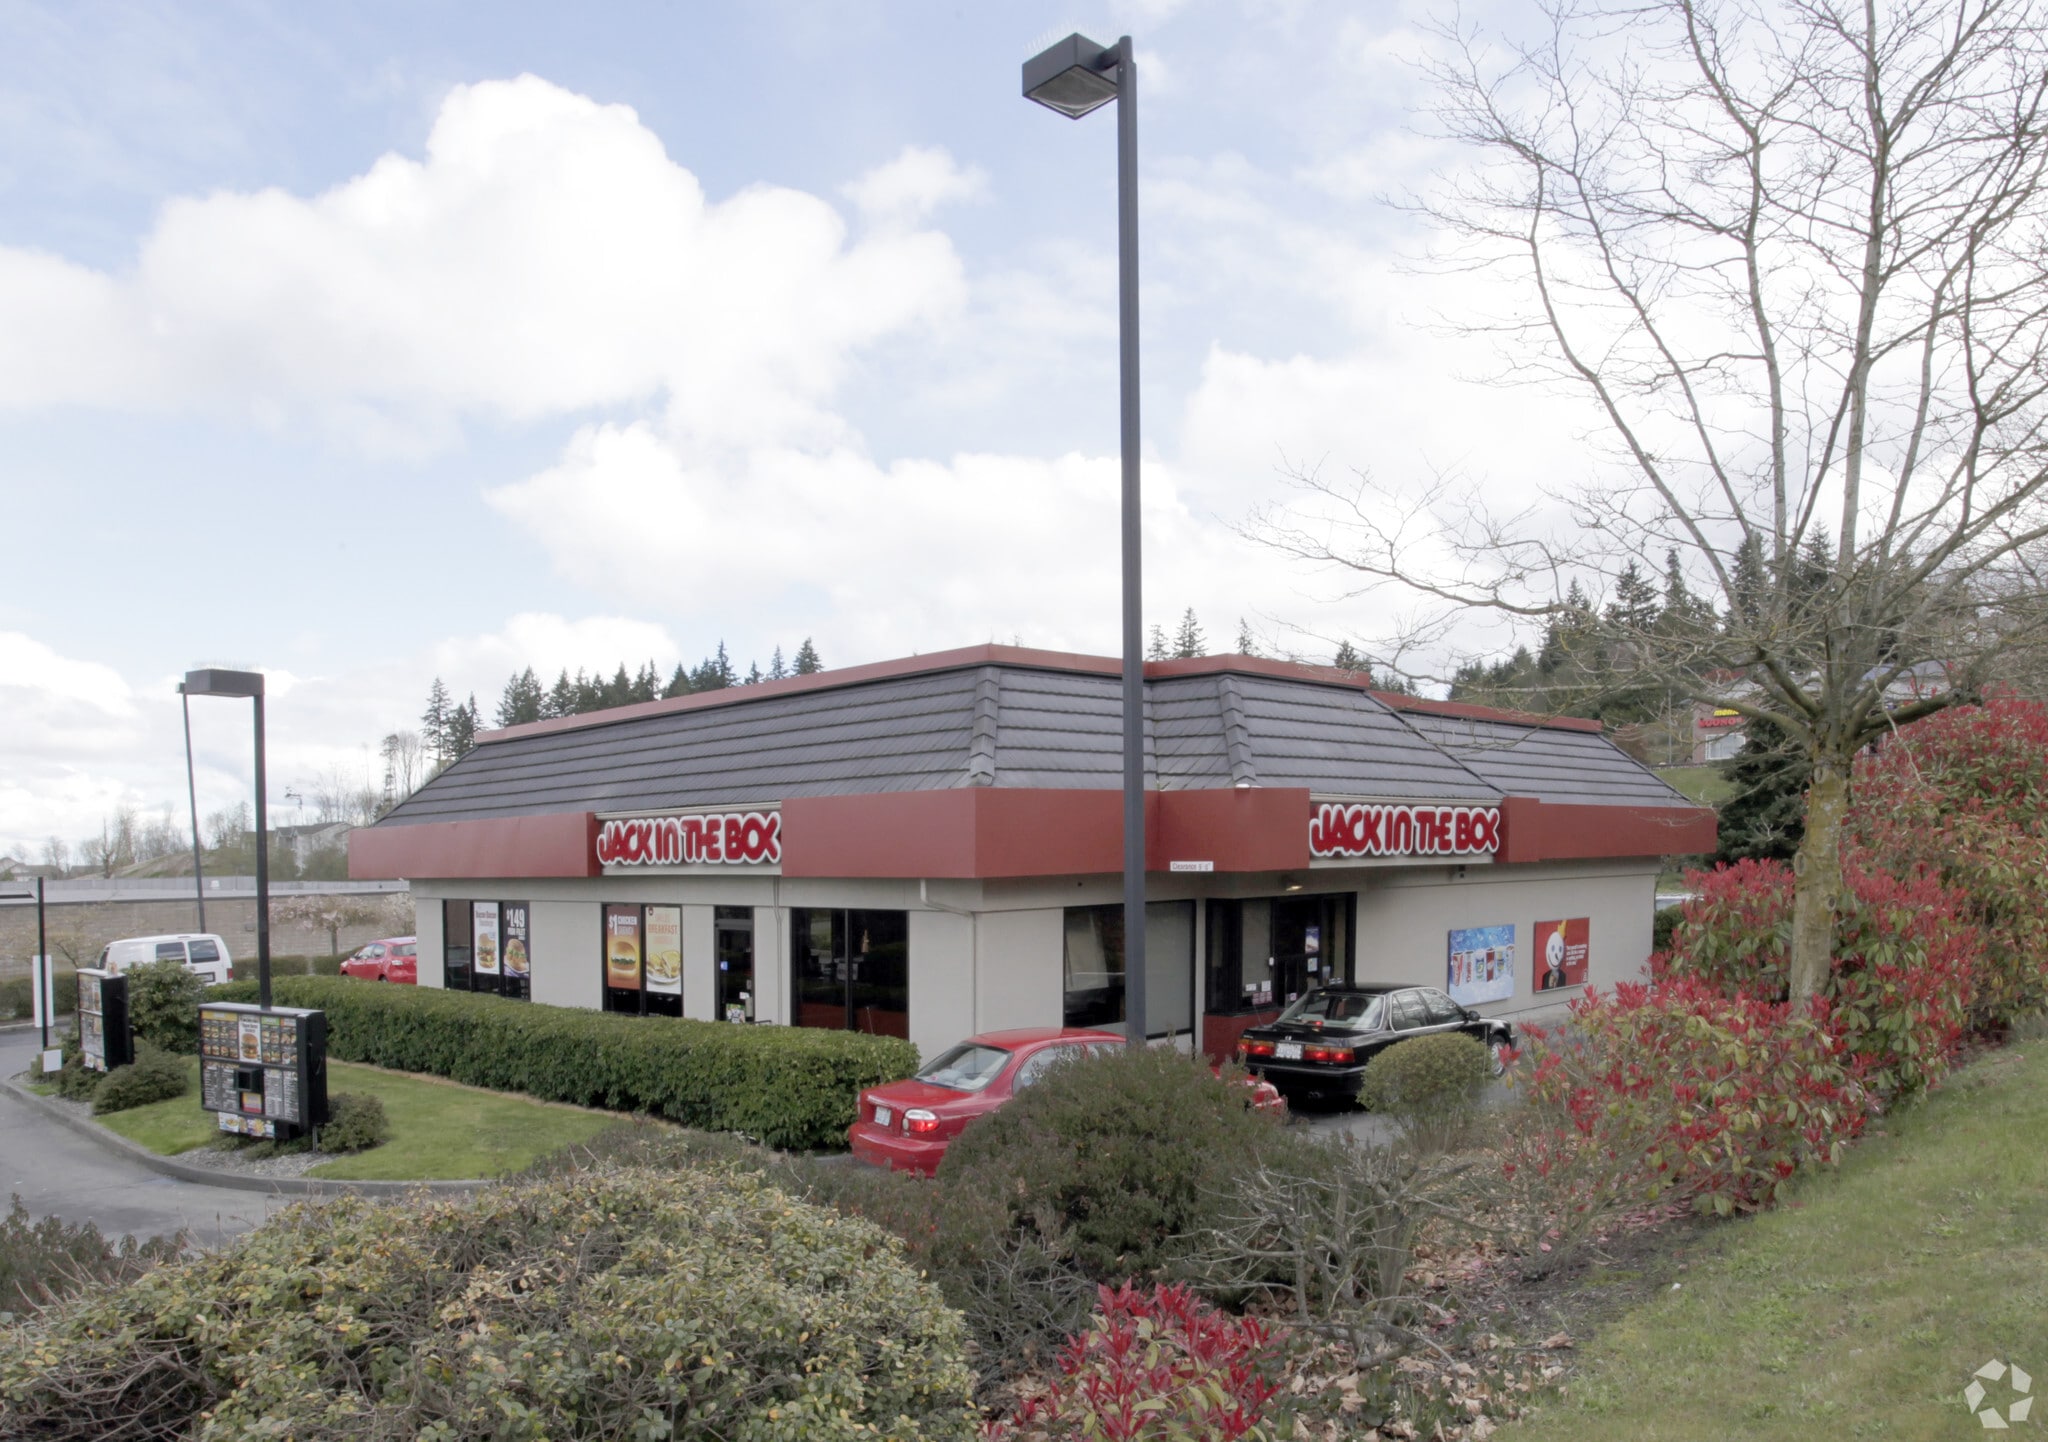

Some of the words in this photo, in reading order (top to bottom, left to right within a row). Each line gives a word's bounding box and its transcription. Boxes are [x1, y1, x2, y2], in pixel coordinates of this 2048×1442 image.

[597, 817, 654, 865] JACK
[679, 814, 725, 863] THE
[724, 811, 782, 863] BOX
[1309, 804, 1383, 856] JACK
[1412, 806, 1453, 854] THE
[1453, 807, 1500, 854] BOX
[608, 914, 618, 935] $1
[618, 916, 637, 926] CHICKEN
[648, 924, 678, 935] BREAKFAST
